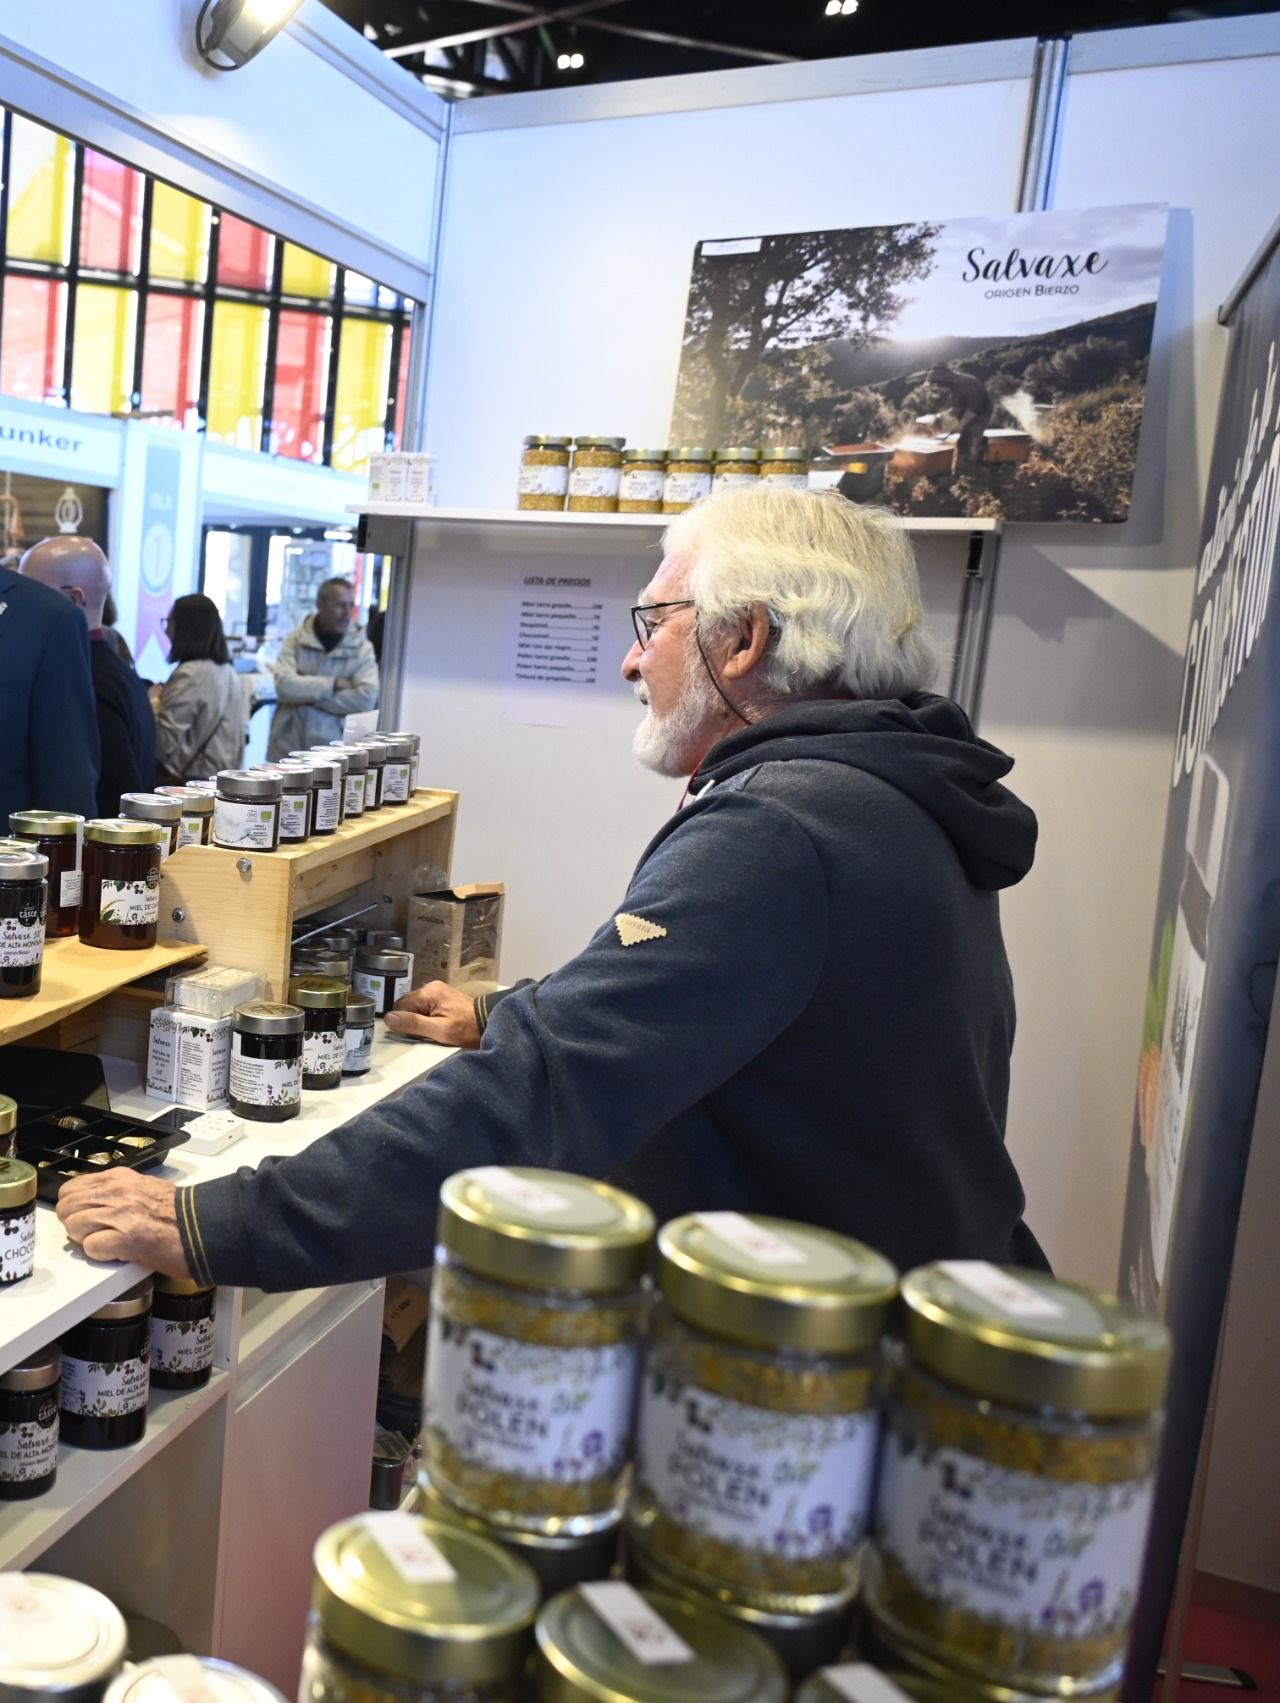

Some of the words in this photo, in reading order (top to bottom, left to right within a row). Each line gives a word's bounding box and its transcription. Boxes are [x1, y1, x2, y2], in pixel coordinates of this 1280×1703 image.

[962, 247, 1109, 282] Salvaxe
[984, 287, 1031, 299] ORIGEN
[5, 1240, 35, 1260] CHOCO
[177, 1347, 193, 1356] MIEL
[96, 1388, 114, 1397] MIEL
[115, 1387, 126, 1396] DE
[126, 1383, 140, 1395] ALTA
[10, 1450, 22, 1459] DE
[23, 1448, 41, 1458] ALTA
